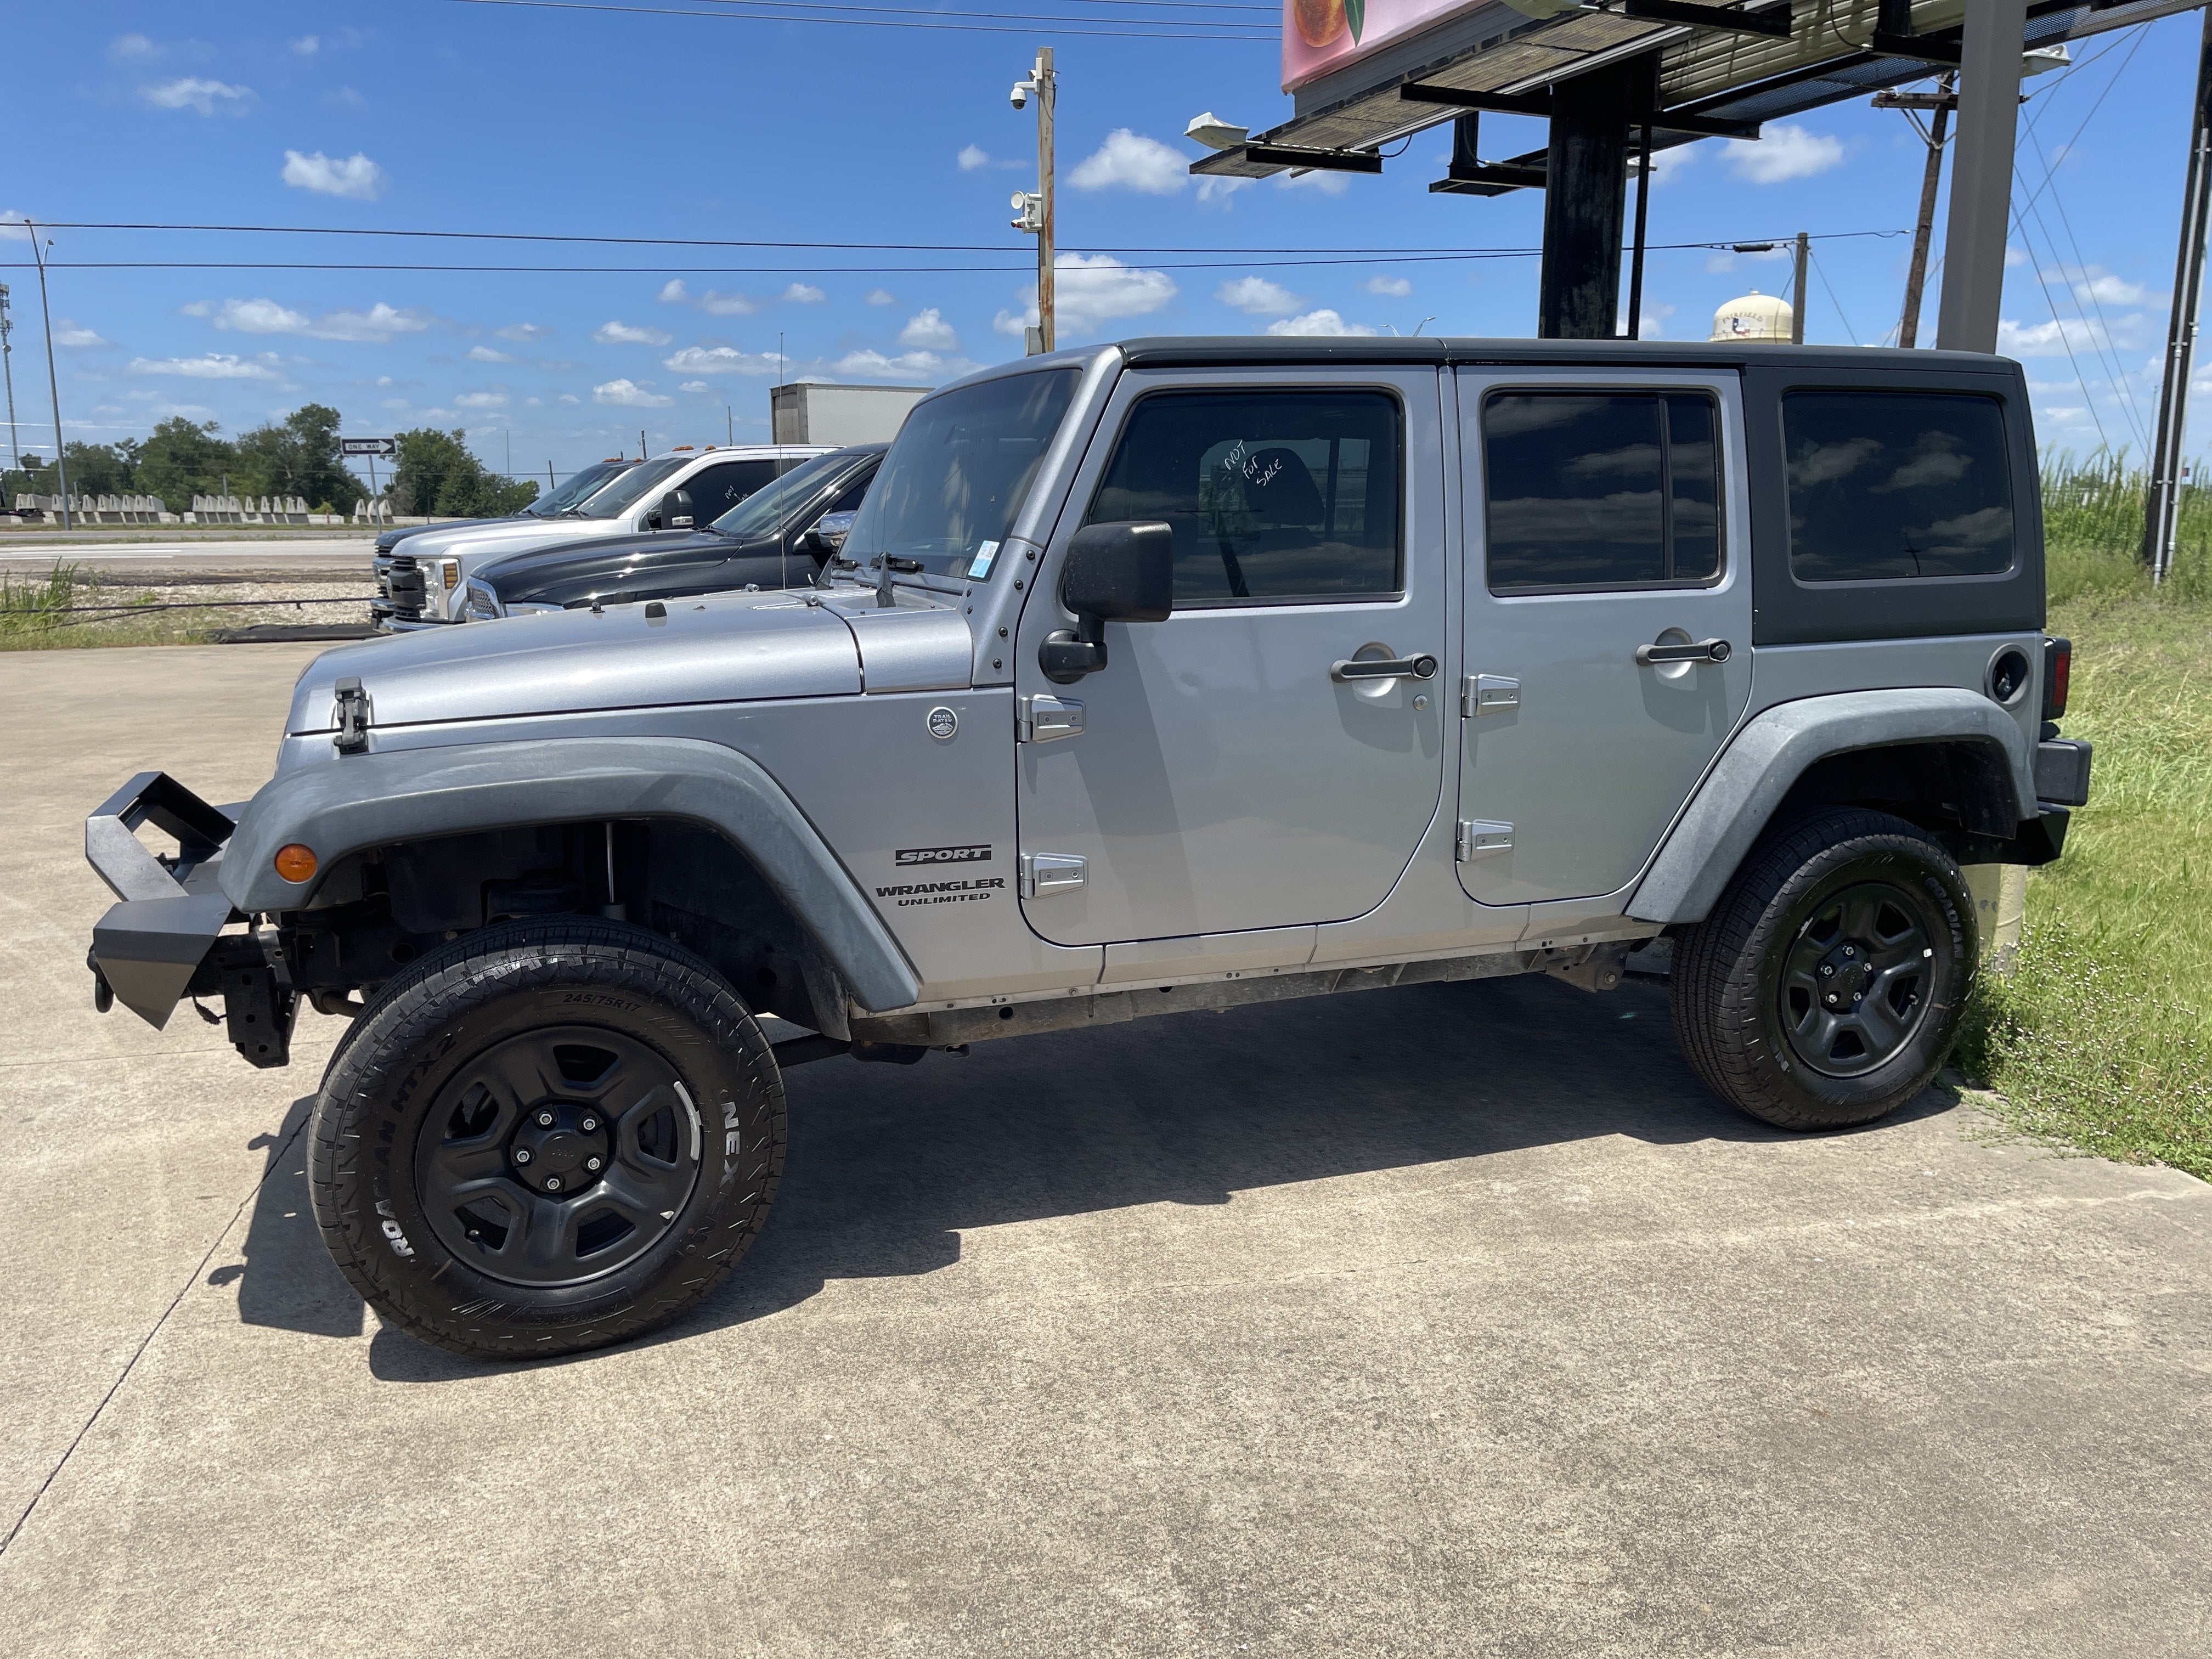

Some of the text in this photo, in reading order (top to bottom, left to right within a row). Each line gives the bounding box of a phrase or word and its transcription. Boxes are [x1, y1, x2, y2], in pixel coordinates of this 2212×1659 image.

[1224, 439, 1246, 470] NOT
[900, 848, 991, 862] SPORT
[876, 877, 1006, 897] WRANGLER
[898, 892, 991, 907] UNLIMITED
[563, 994, 642, 1012] 245/75R17
